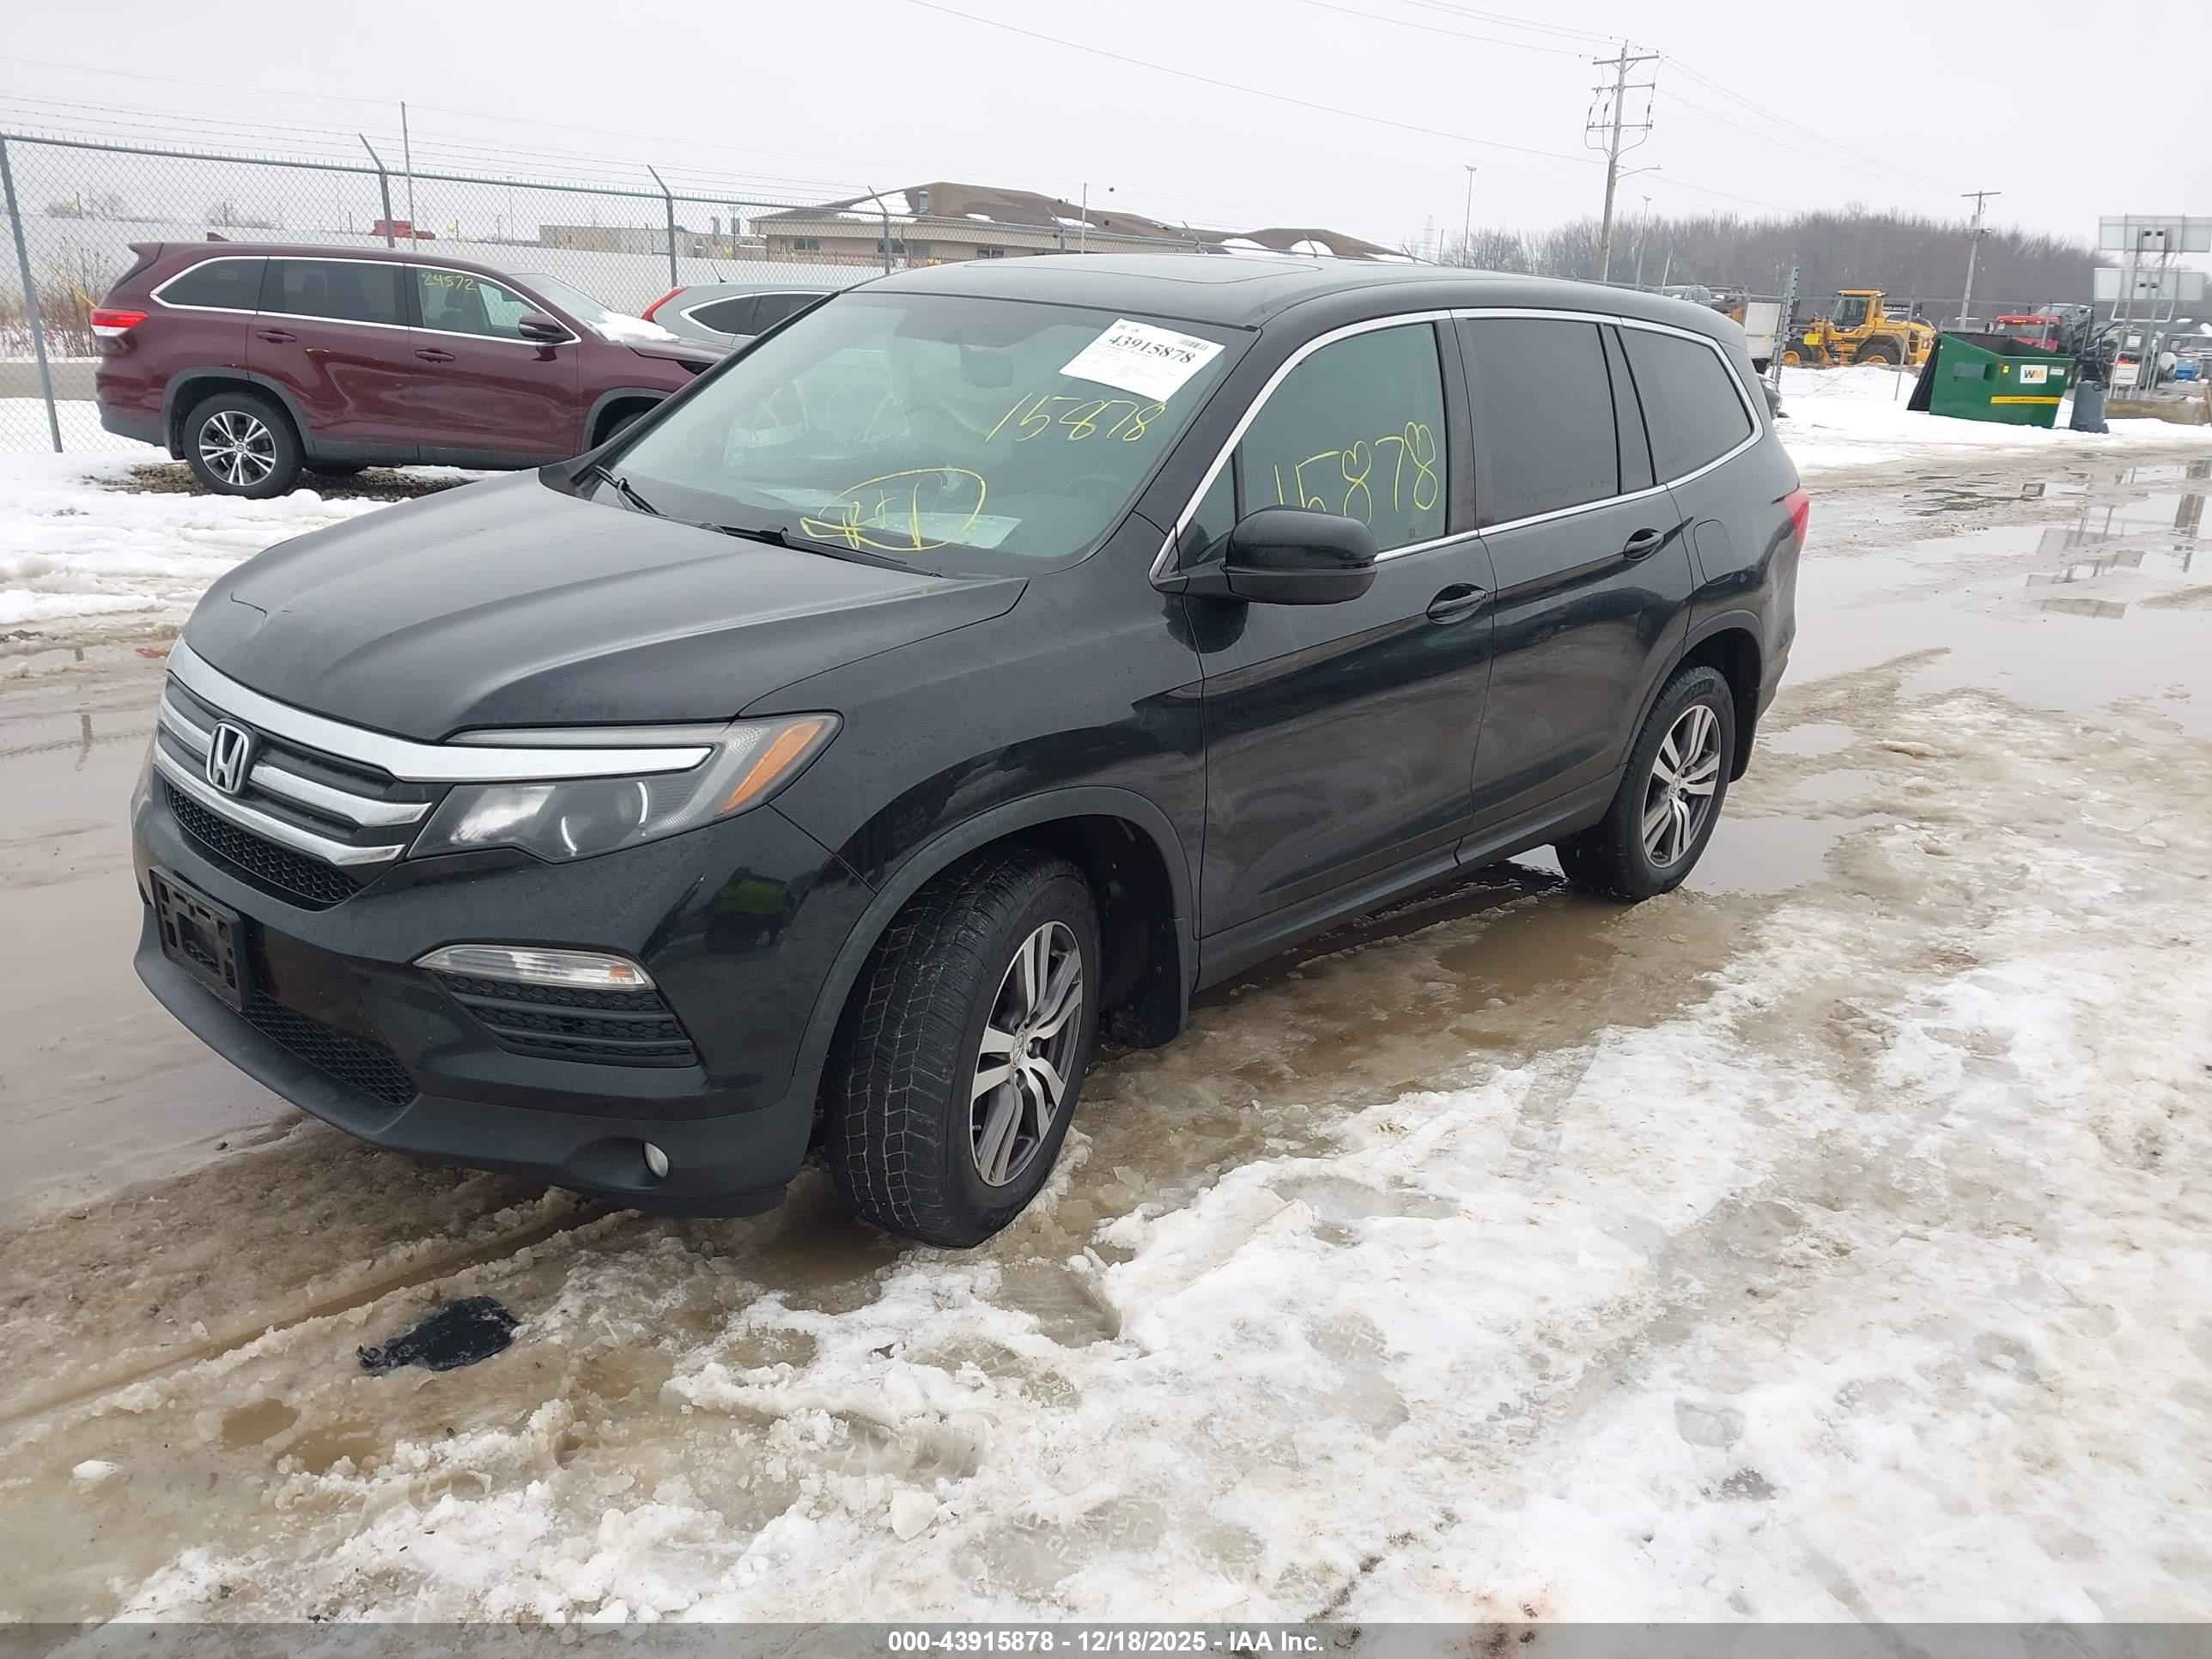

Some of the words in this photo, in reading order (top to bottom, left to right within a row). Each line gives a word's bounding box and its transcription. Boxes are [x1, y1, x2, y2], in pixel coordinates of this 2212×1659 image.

[1109, 334, 1196, 363] 43915878
[2023, 369, 2044, 379] WM
[986, 392, 1168, 441] 15878
